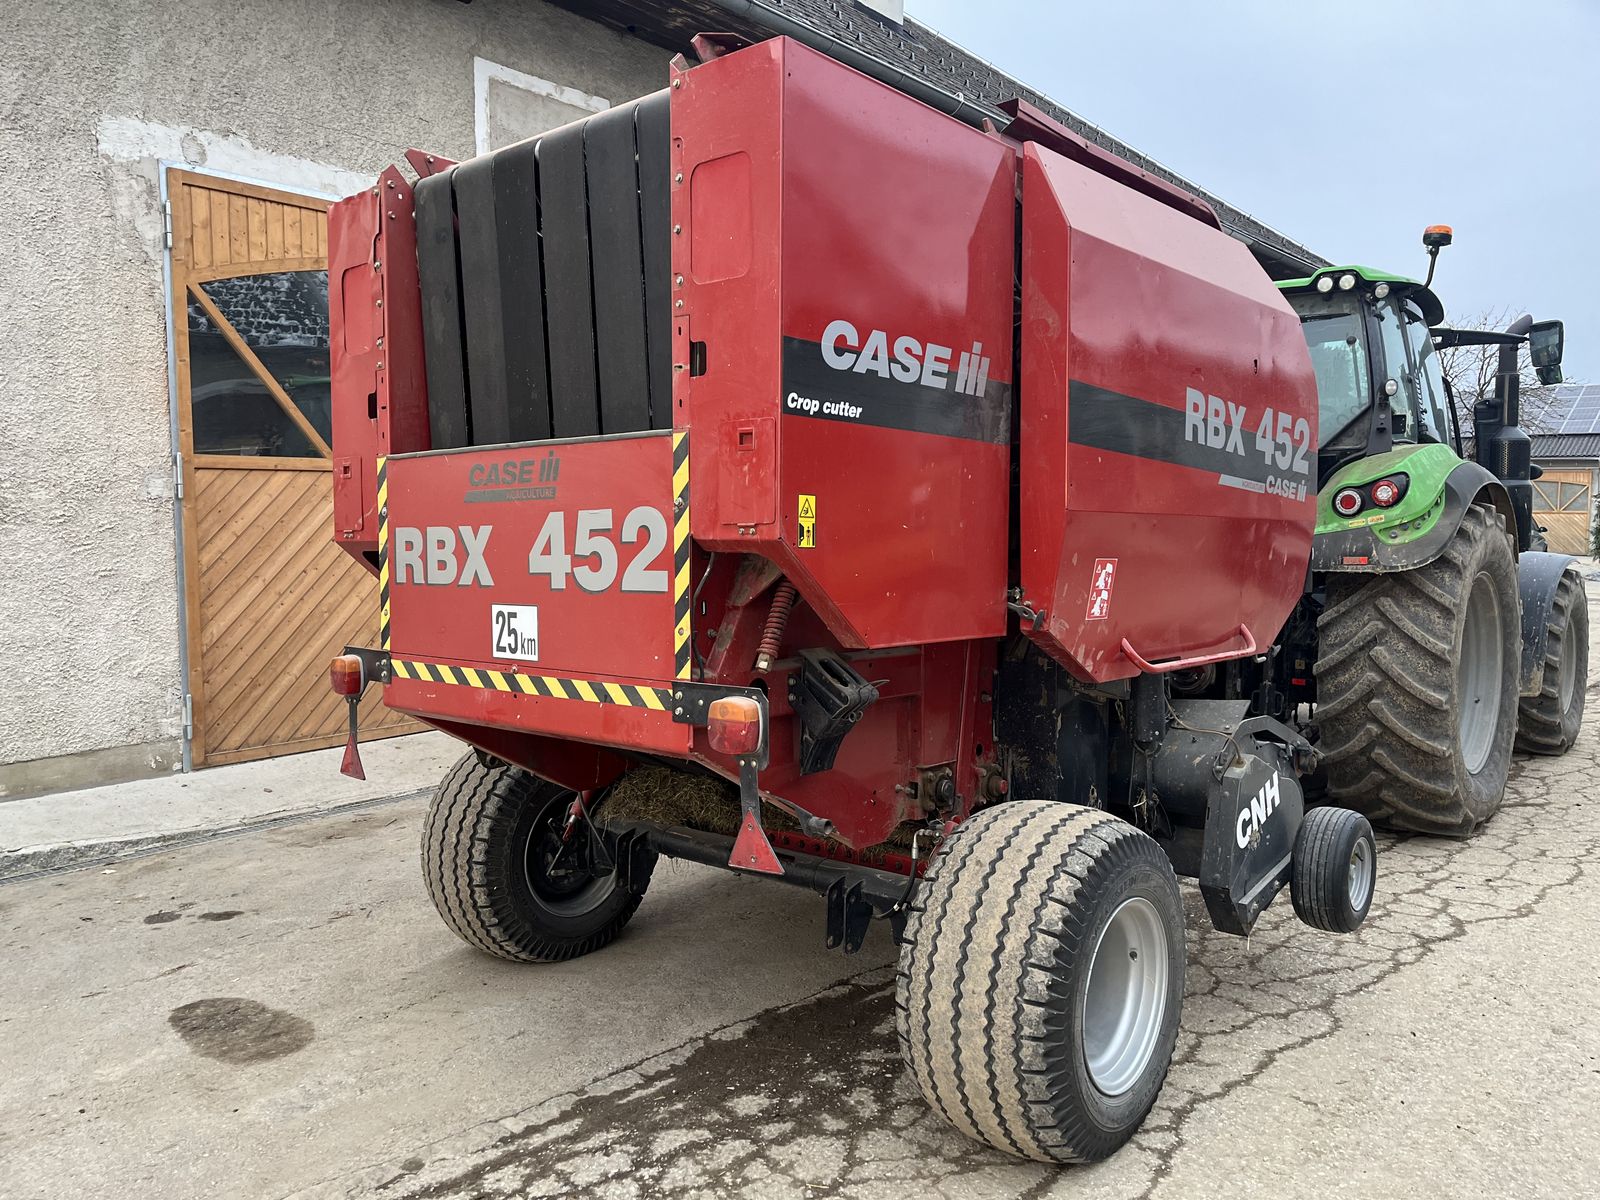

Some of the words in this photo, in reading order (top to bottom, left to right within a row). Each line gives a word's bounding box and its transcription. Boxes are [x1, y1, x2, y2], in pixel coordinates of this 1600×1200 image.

[821, 319, 953, 390] CASE
[787, 392, 820, 415] Crop
[823, 401, 863, 418] cutter
[1184, 386, 1247, 457] RBX
[1255, 407, 1310, 475] 452
[469, 460, 535, 487] CASE
[1266, 475, 1297, 500] CASE
[395, 525, 496, 587] RBX
[528, 505, 670, 593] 452
[495, 610, 518, 654] 25
[520, 631, 536, 656] km
[1236, 770, 1281, 849] CNH
